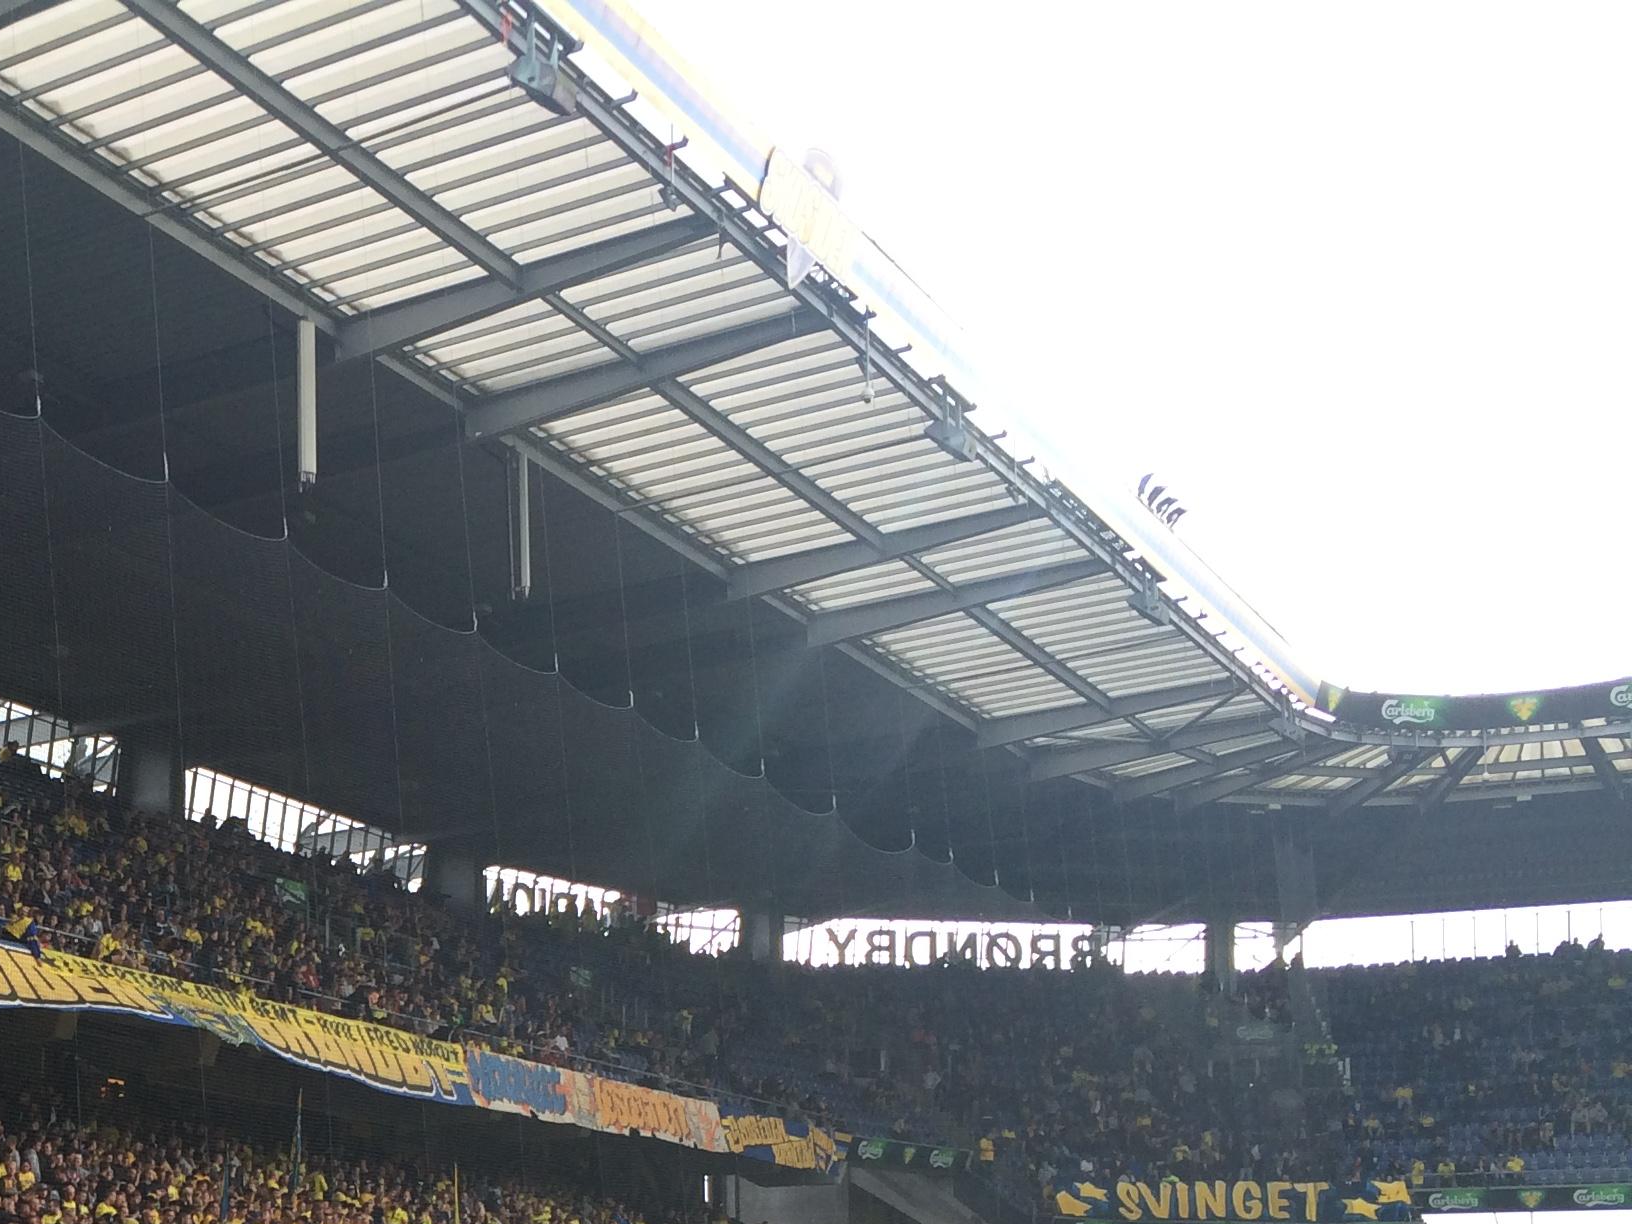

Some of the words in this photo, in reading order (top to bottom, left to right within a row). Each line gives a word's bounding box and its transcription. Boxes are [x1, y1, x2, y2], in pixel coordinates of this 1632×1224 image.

[1381, 699, 1435, 725] Carlsberg
[1117, 1180, 1330, 1222] SVINGET
[1428, 1192, 1479, 1211] Carlsberg
[1573, 1188, 1625, 1207] Carlsberg
